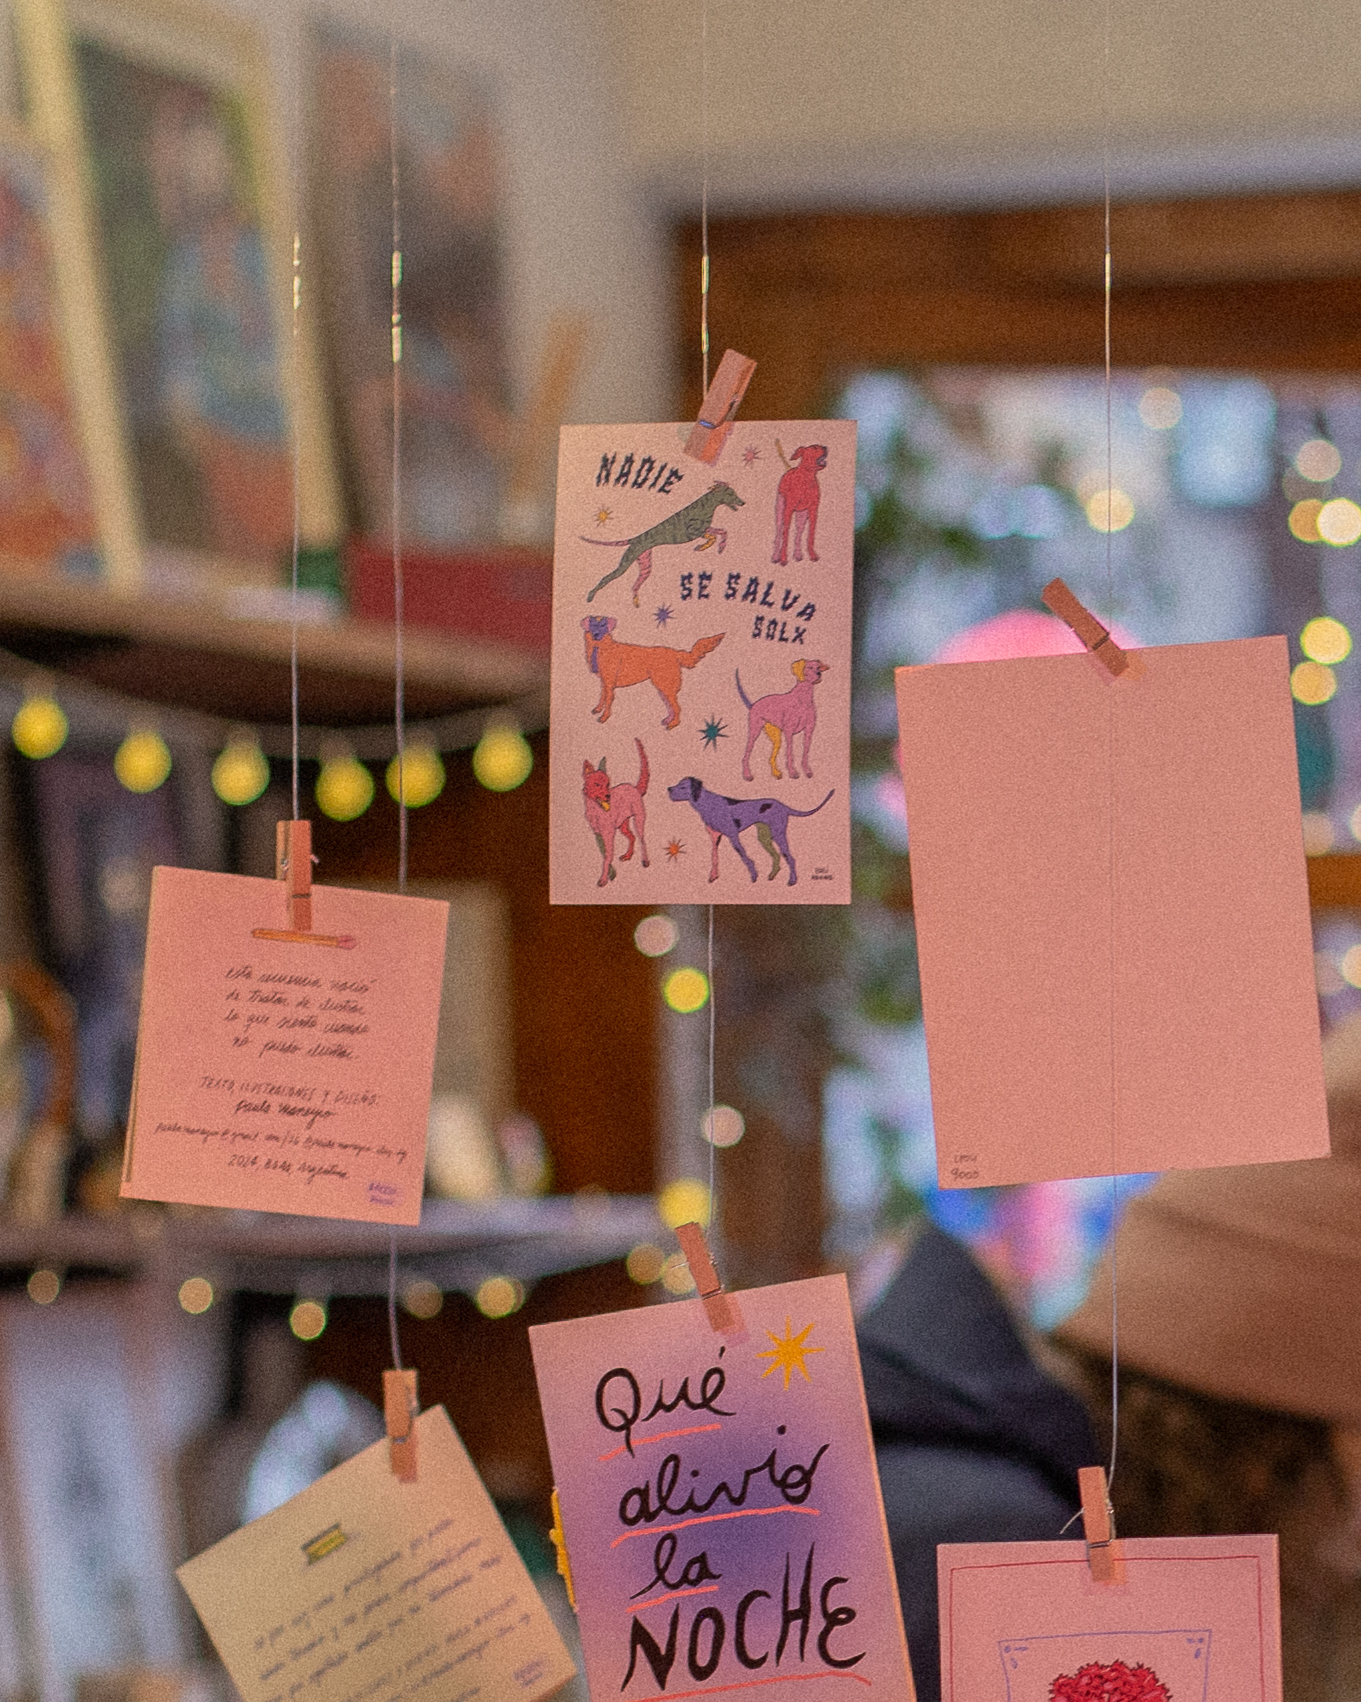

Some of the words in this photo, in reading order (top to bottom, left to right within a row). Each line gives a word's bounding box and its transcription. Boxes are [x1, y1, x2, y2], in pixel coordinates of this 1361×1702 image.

[596, 453, 684, 494] NADIE
[680, 572, 712, 601] SE
[725, 573, 816, 620] SALVA
[752, 616, 807, 645] SOLX
[595, 1345, 736, 1458] Qué
[619, 1424, 830, 1528] alivio
[630, 1532, 722, 1600] la
[620, 1542, 867, 1692] NOCHE
